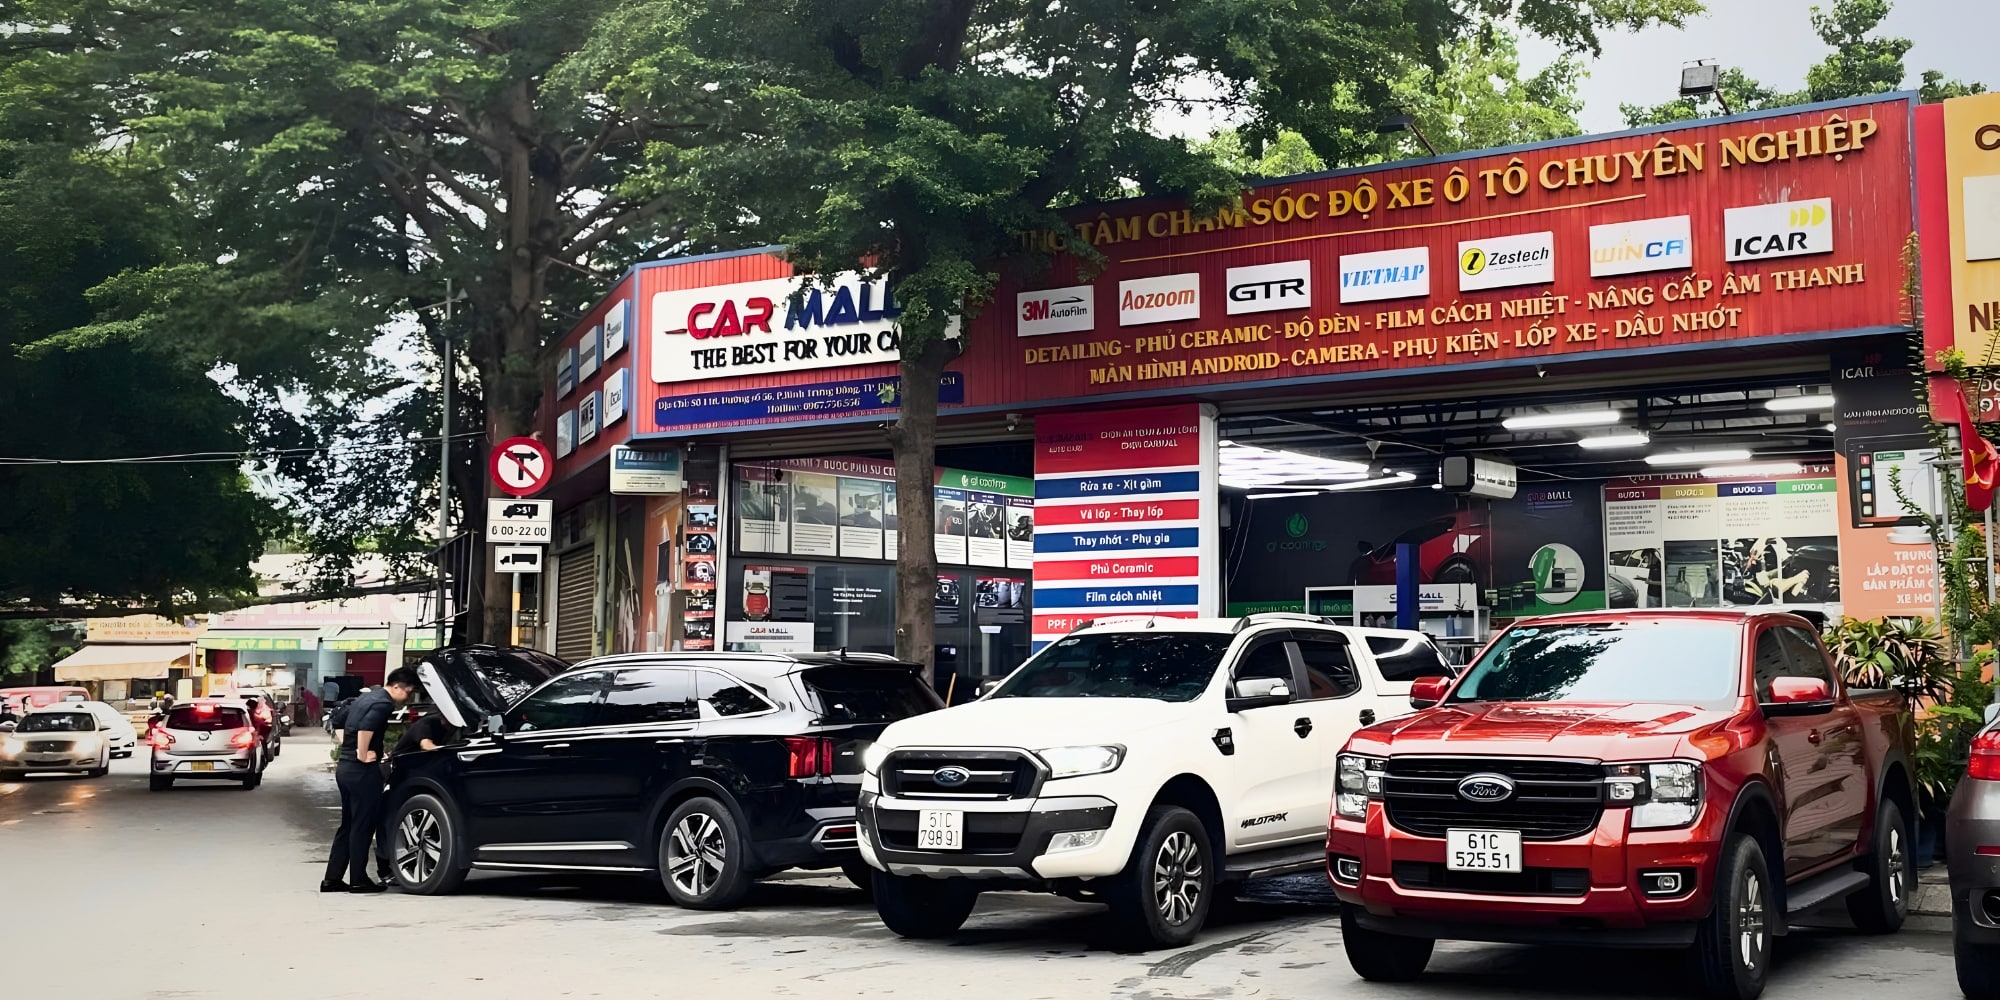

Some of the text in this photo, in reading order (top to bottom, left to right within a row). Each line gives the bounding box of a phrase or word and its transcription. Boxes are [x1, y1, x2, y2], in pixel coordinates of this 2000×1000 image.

[1074, 211, 1142, 246] TÂM
[1252, 187, 1320, 225] SÓC
[1328, 177, 1378, 220] ĐỘ
[1387, 178, 1435, 210] XE
[1443, 166, 1471, 202] Ô
[1478, 156, 1530, 197] TÔ
[1539, 136, 1705, 190] CHUYÊN
[1720, 113, 1877, 168] NGHIỆP
[1734, 231, 1808, 257] ICAR
[1488, 246, 1550, 267] Zestech
[1342, 264, 1426, 288] VIETMAP
[1121, 288, 1196, 312] Aozoom
[1229, 277, 1306, 302] GTR
[687, 284, 900, 340] CAR MALL
[1022, 299, 1088, 322] 3M AutoFilm
[1025, 339, 1122, 365] DETAILING
[1135, 329, 1176, 354] PHỦ
[1180, 324, 1272, 348] CERAMIC
[1284, 316, 1314, 342] ĐỘ
[1319, 313, 1360, 335] ĐÈN
[1376, 308, 1425, 330] FILM
[1430, 300, 1492, 325] CÁCH
[1500, 290, 1569, 319] NHIỆT
[1588, 285, 1654, 310] NÂNG
[1662, 273, 1713, 301] CẤP
[1721, 272, 1761, 296] ÂM
[1770, 263, 1865, 292] THANH
[690, 330, 901, 370] THE BEST FOR YOUR CA
[1089, 363, 1132, 385] MÀN
[1140, 358, 1187, 380] HÌNH
[1190, 352, 1280, 376] ANDROID
[1291, 342, 1380, 367] CAMERA
[1392, 337, 1438, 360] PHỤ
[1446, 328, 1499, 356] KIỆN
[1514, 319, 1558, 348] LỐP
[1566, 323, 1598, 342] XE
[1615, 309, 1664, 339] DẦU
[1671, 302, 1742, 333] NHỚT
[1841, 367, 1874, 380] ICAR
[1112, 562, 1154, 573] Ceramic
[1086, 591, 1107, 602] Film
[1047, 619, 1067, 630] PPF
[1470, 782, 1500, 796] Ford
[929, 812, 953, 828] 51C
[1240, 811, 1289, 829] WILDTRAK
[1468, 833, 1498, 850] 61C
[1455, 851, 1510, 869] 525.51
